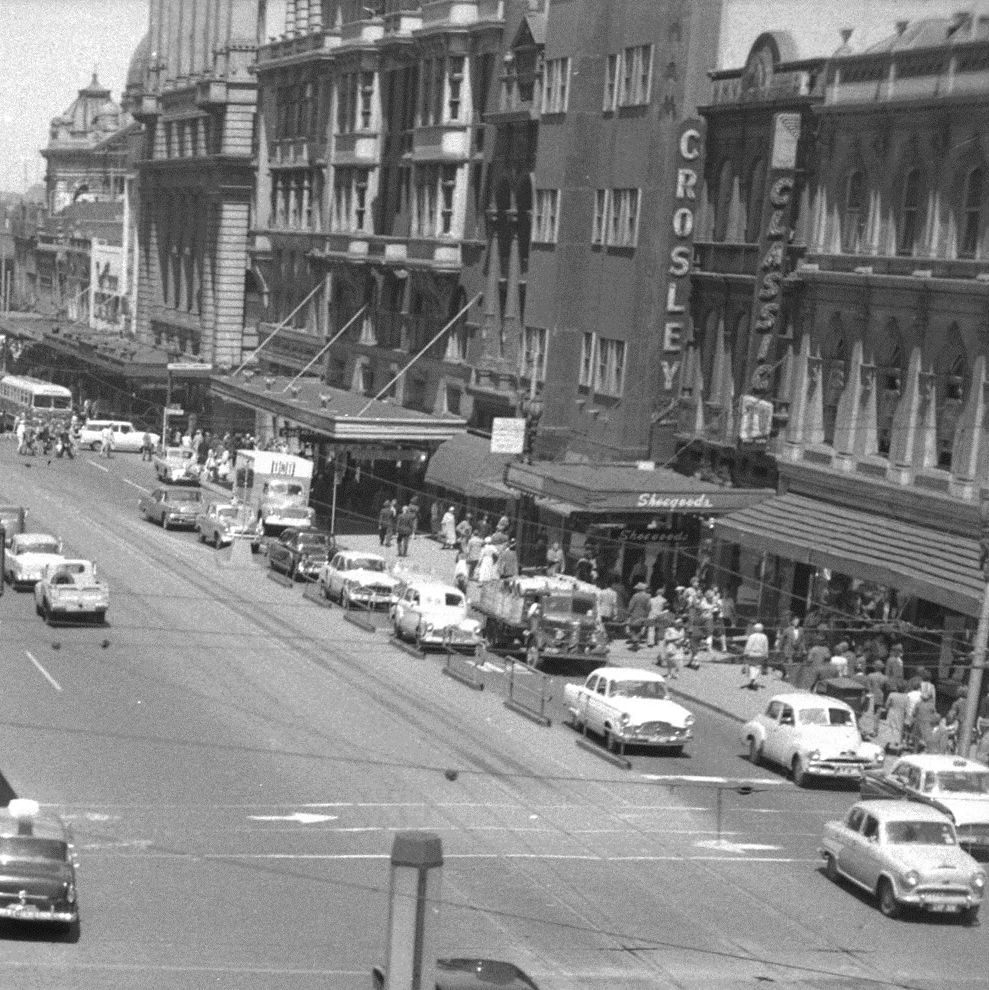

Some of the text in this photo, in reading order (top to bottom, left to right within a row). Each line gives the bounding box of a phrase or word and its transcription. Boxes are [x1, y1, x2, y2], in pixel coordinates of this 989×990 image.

[662, 128, 701, 391] CROSLEY
[751, 177, 795, 390] CLASSIC
[636, 493, 713, 512] Shoegoods
